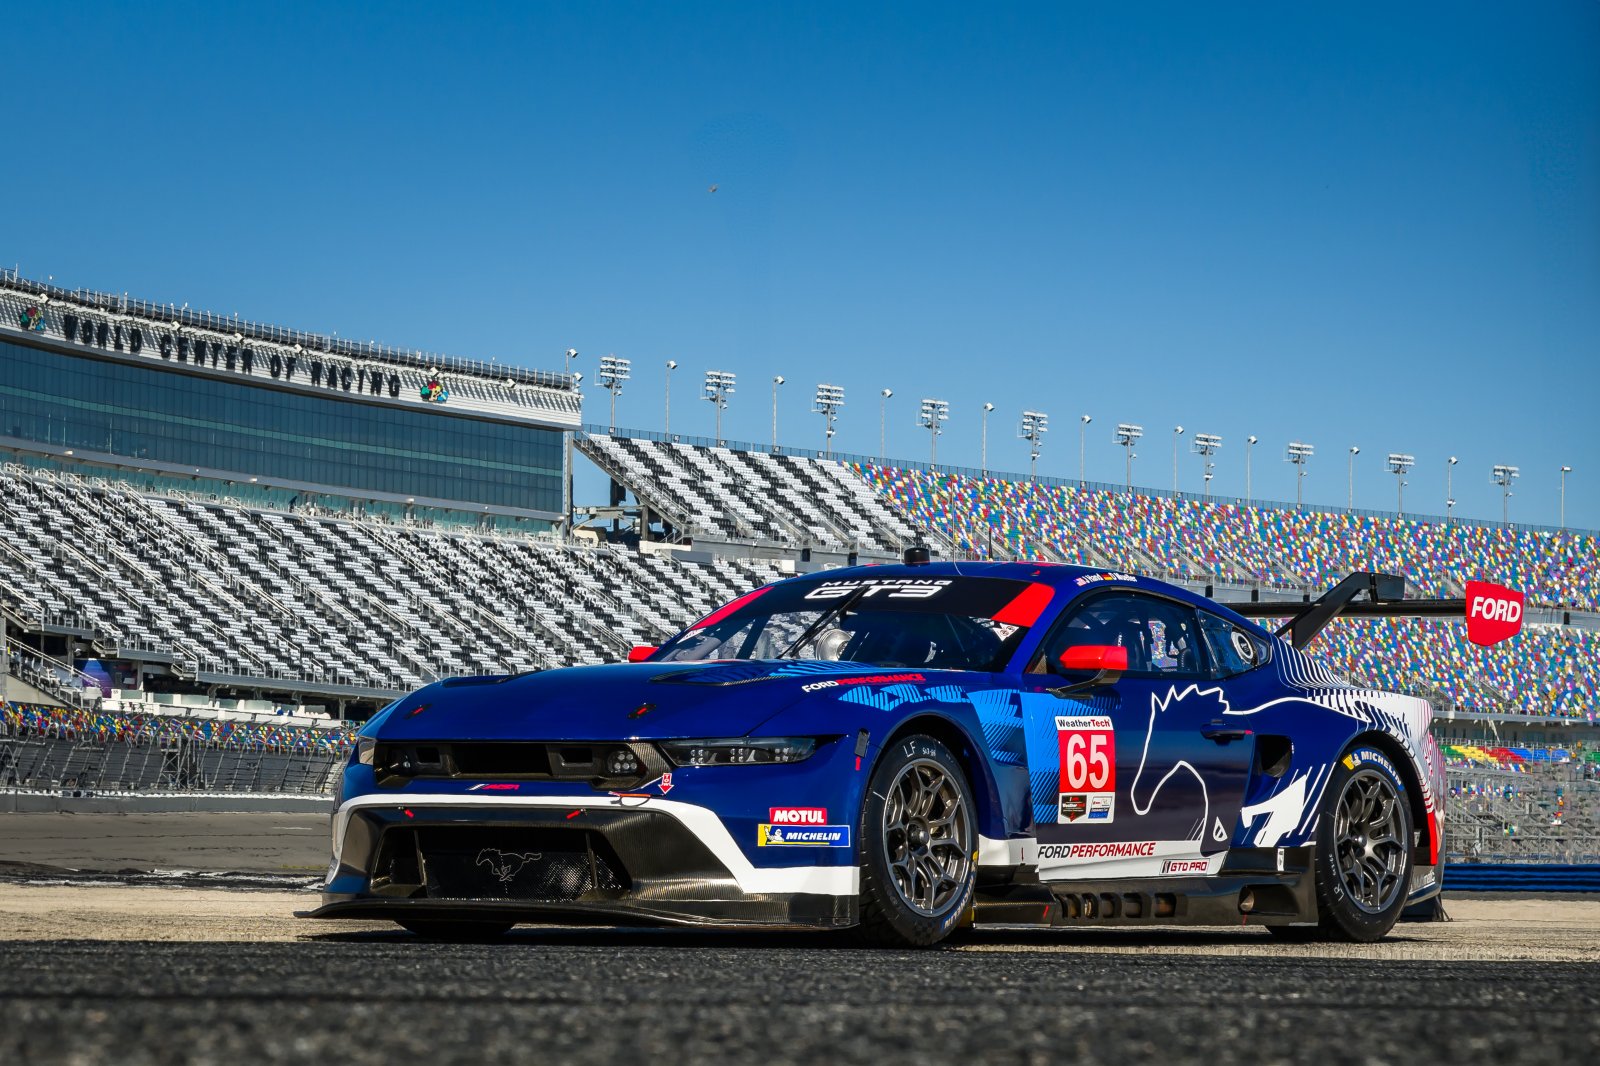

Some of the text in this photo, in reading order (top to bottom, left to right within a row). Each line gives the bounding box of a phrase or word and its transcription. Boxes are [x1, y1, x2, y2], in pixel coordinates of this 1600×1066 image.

[63, 313, 401, 398] WORLD CENTER OF RACING
[822, 579, 953, 587] MUSTANG
[804, 585, 943, 599] GT3
[1471, 596, 1521, 622] FORD
[1057, 719, 1110, 727] WeatherTech
[903, 740, 916, 758] LF
[1066, 733, 1109, 789] 65
[1360, 751, 1402, 786] MICHELIN
[773, 809, 825, 823] MOTUL
[785, 832, 841, 841] MICHELIN
[1170, 861, 1207, 872] GTD PRO
